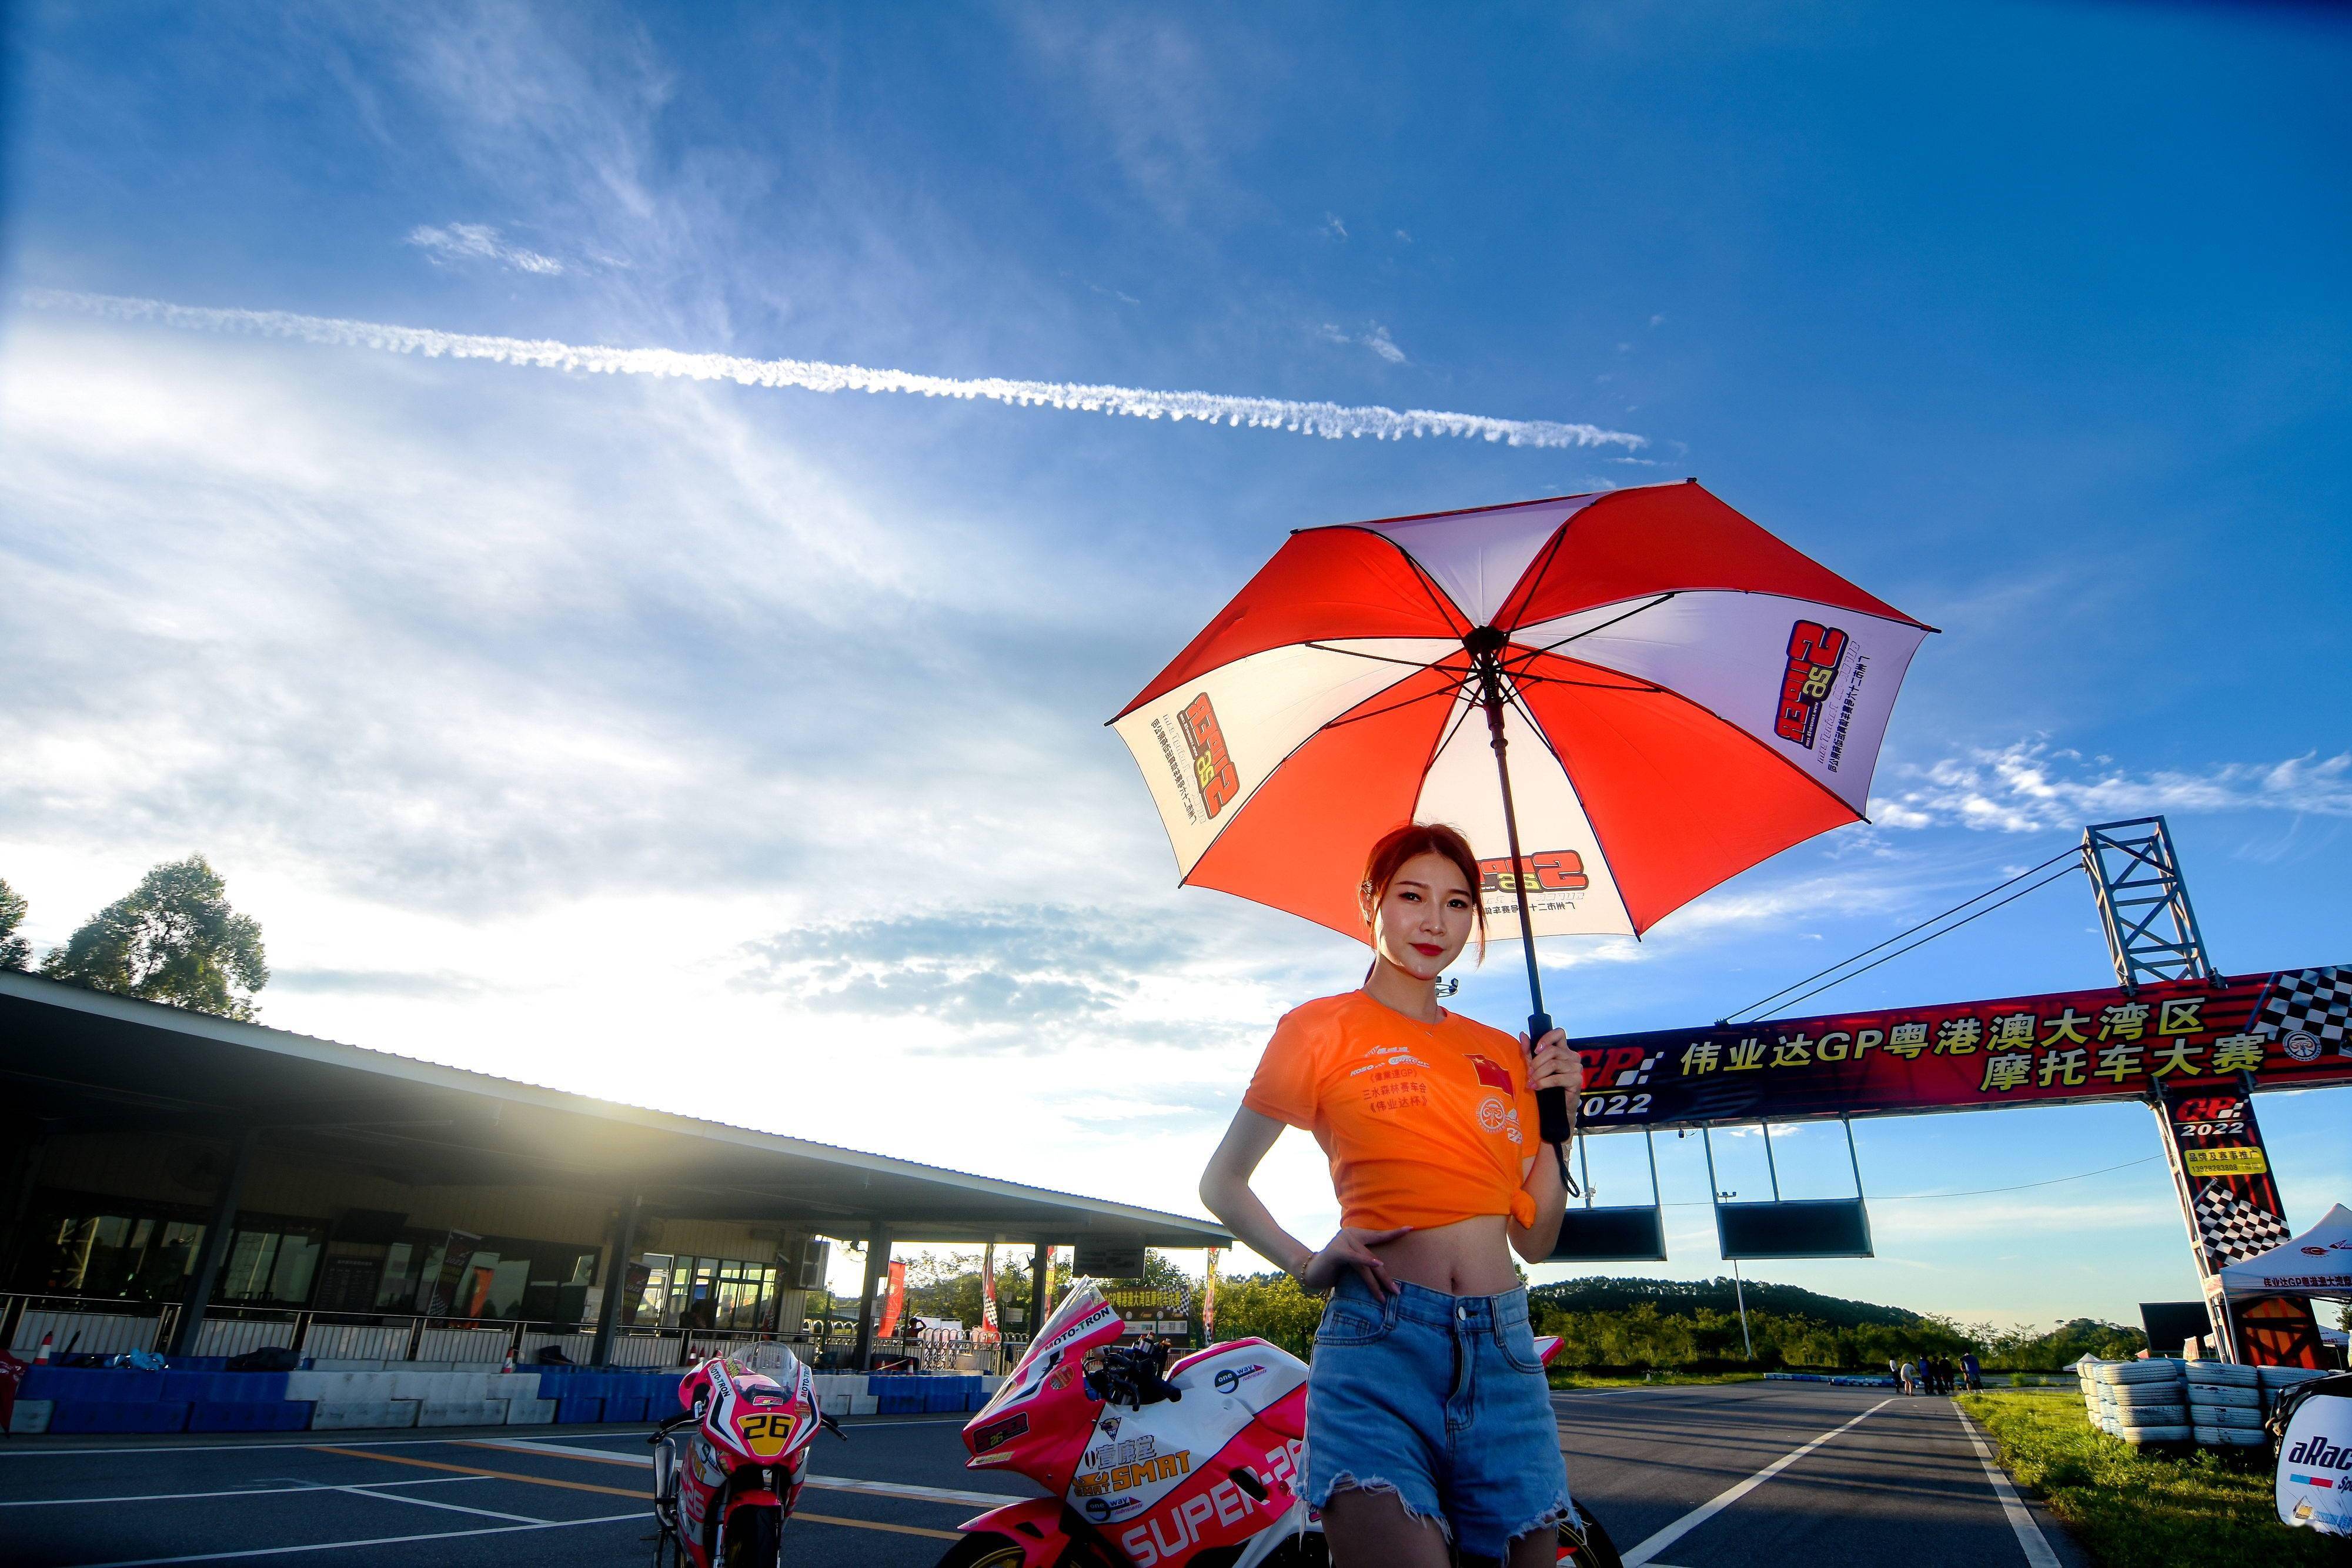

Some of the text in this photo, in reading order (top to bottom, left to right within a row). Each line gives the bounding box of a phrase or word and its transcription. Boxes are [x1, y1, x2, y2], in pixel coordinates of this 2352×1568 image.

[1681, 997, 2206, 1076] 伟业达GP粤港澳大湾区
[1979, 1033, 2267, 1093] 摩托车大赛
[1363, 1082, 1426, 1100] 三水森林赛车会
[2180, 1122, 2244, 1136] 2022
[2189, 1150, 2259, 1162] 品牌及赛事推广
[1045, 1307, 1110, 1351] MOTO-TRON
[1218, 1365, 1252, 1382] one way
[744, 1416, 790, 1439] 26
[990, 1432, 1003, 1446] 26
[1110, 1497, 1128, 1506] way
